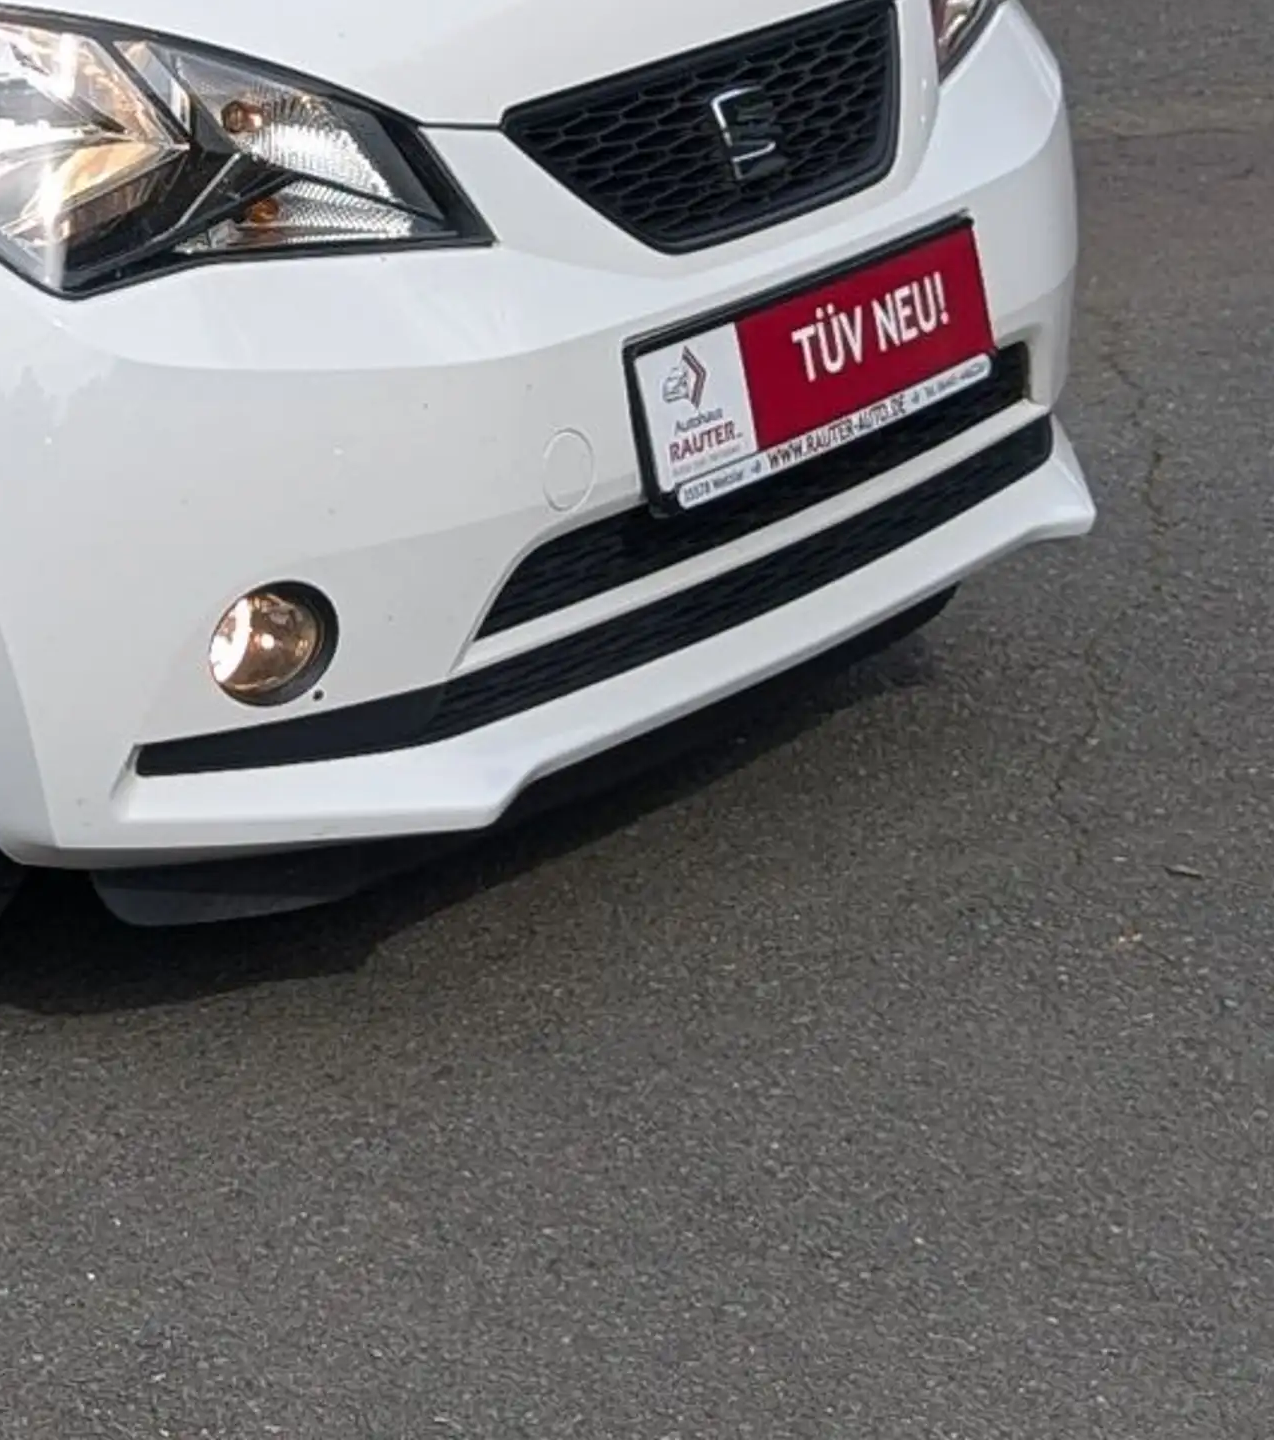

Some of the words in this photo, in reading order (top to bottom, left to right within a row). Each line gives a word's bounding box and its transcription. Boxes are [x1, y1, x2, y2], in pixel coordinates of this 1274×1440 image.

[791, 302, 865, 384] TÜV
[871, 270, 950, 353] NEU!
[668, 419, 737, 464] RAUTER
